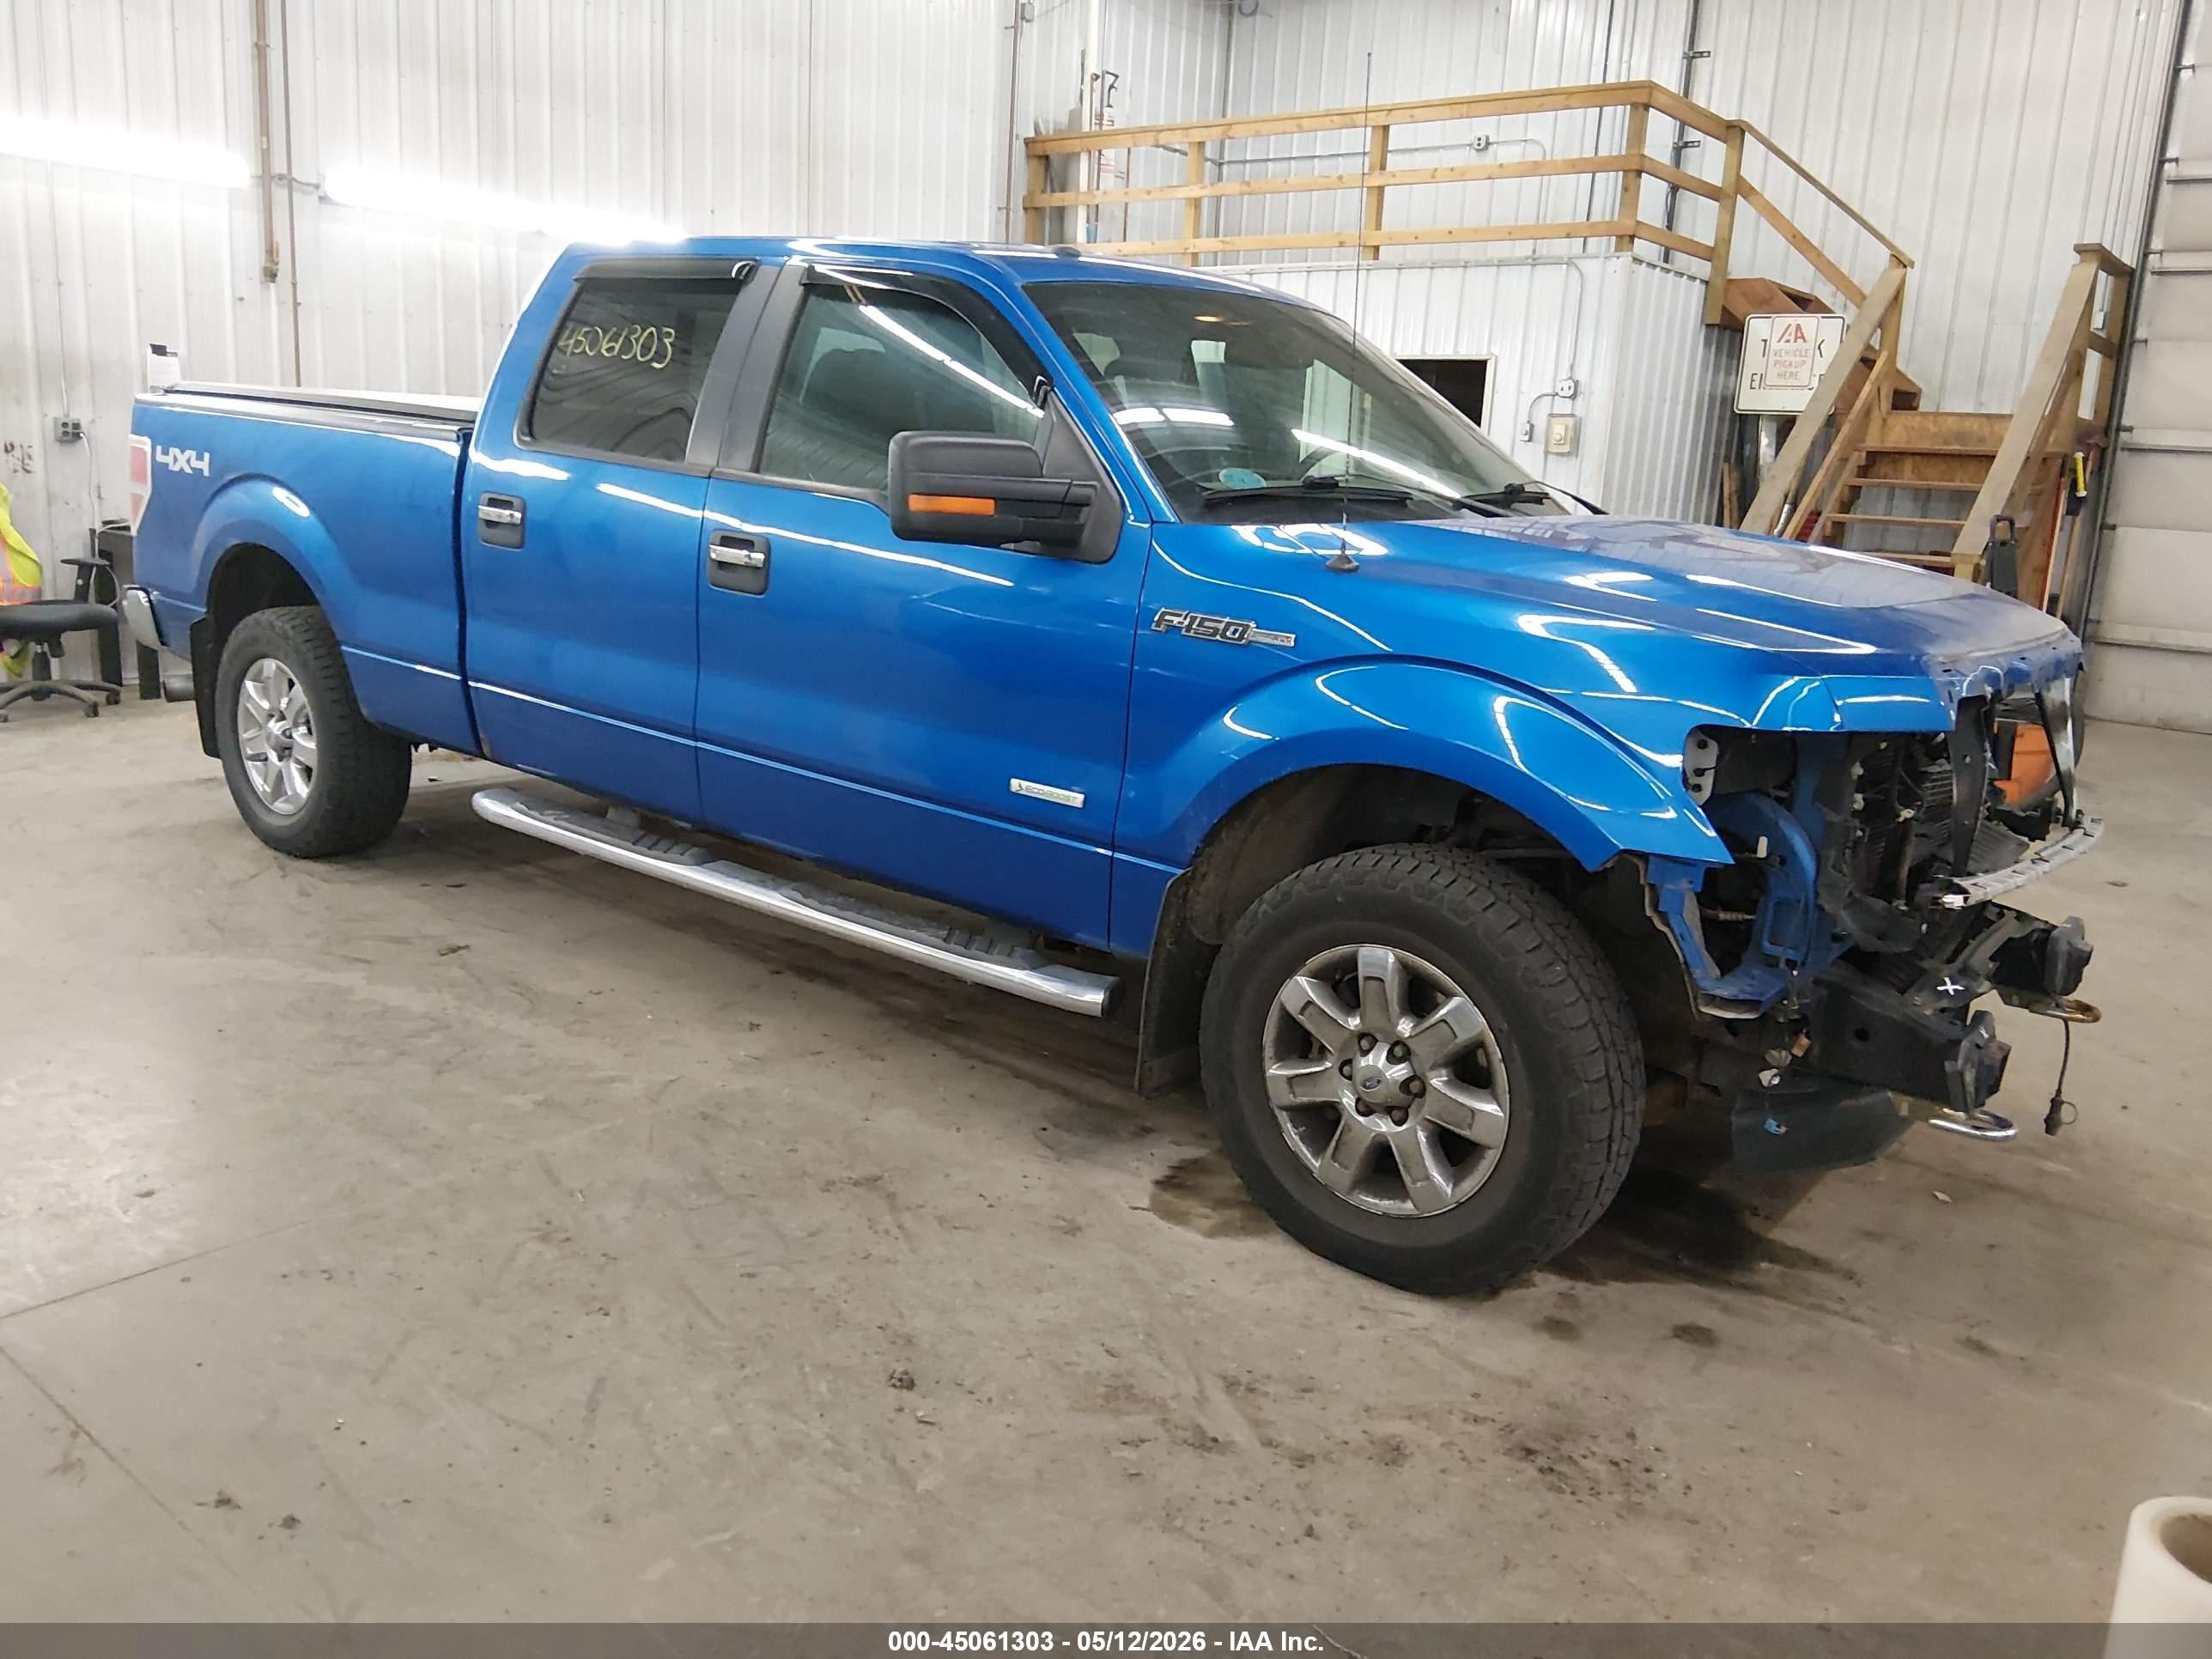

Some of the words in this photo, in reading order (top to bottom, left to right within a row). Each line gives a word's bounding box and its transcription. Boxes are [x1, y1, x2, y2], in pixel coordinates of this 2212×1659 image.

[558, 322, 675, 369] 45061303
[1772, 348, 1811, 358] VEHICLE
[1772, 360, 1807, 370] PICKUP
[1776, 371, 1801, 380] HERE
[1152, 608, 1255, 644] F-150
